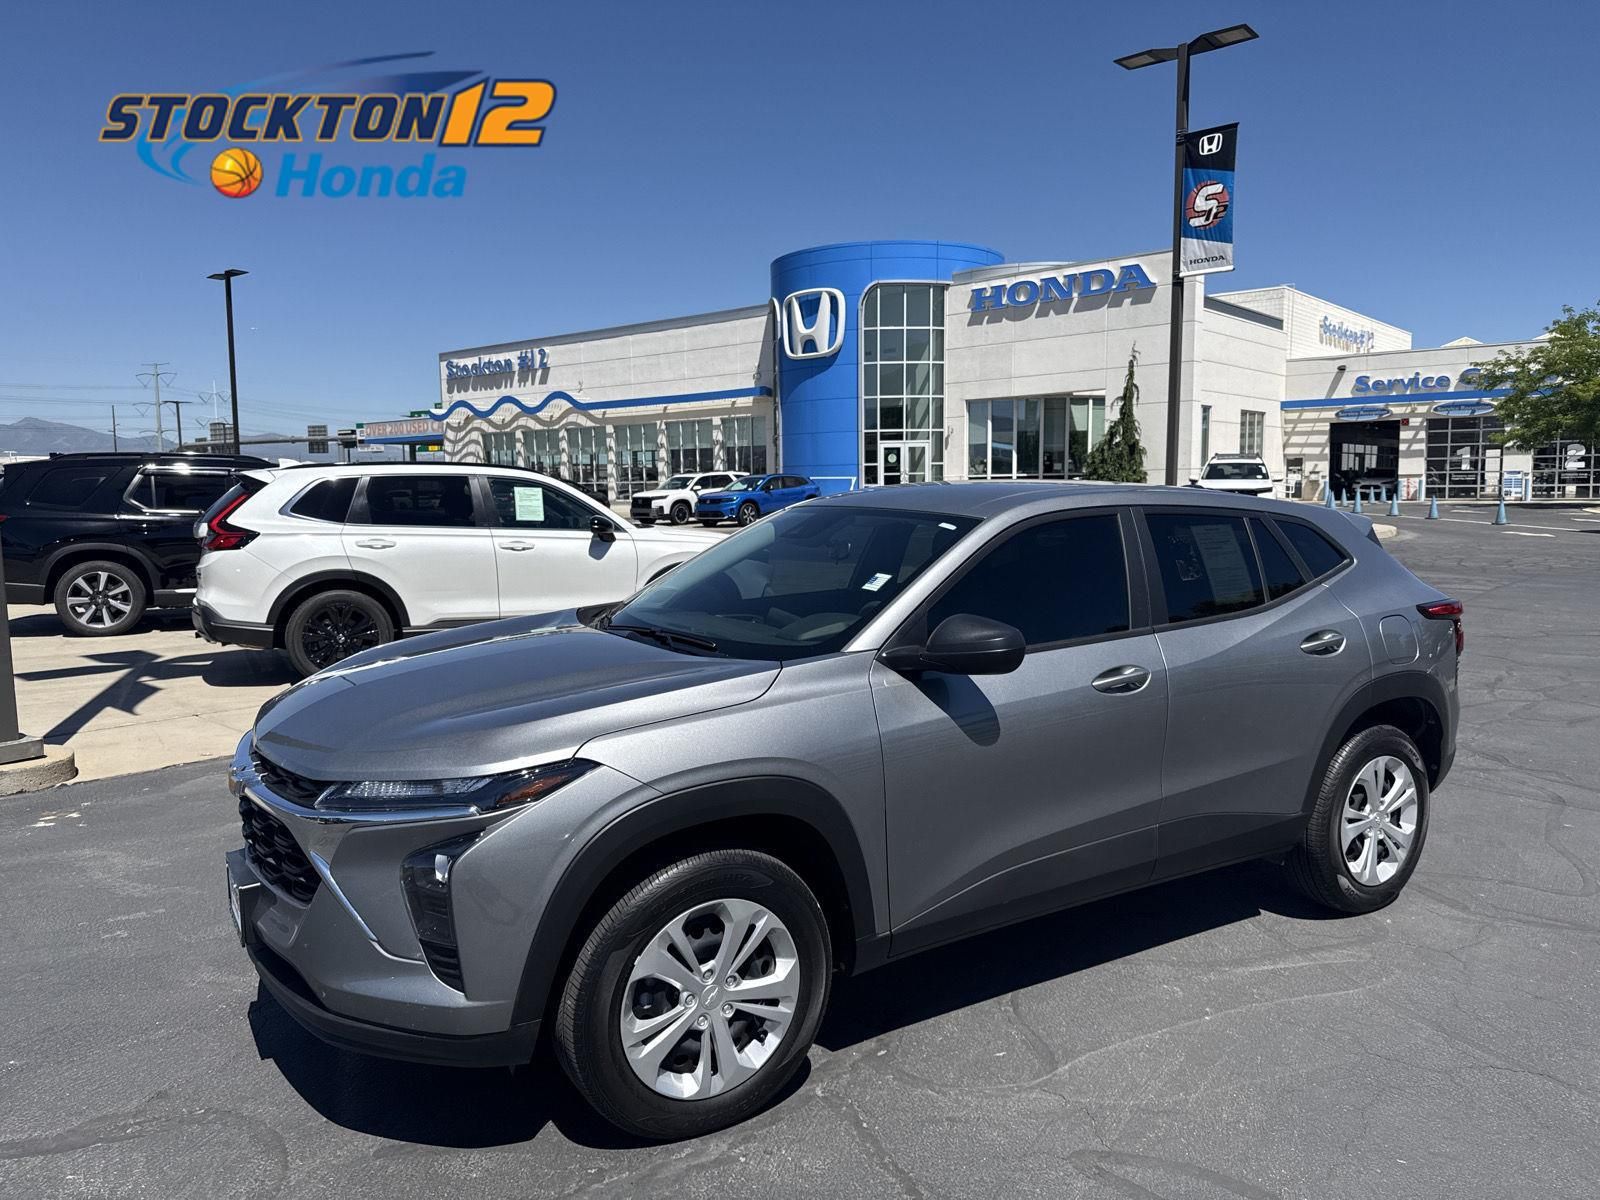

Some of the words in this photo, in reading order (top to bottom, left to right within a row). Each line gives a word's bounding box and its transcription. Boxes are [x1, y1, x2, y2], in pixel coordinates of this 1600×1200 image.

[1189, 255, 1226, 265] HONDA
[970, 263, 1157, 312] HONDA
[445, 356, 513, 380] Stockton
[517, 348, 548, 369] #12
[1354, 371, 1451, 395] Service
[365, 423, 387, 437] OVER
[406, 420, 429, 434] USED
[1456, 446, 1471, 471] 1
[1564, 443, 1587, 470] 2
